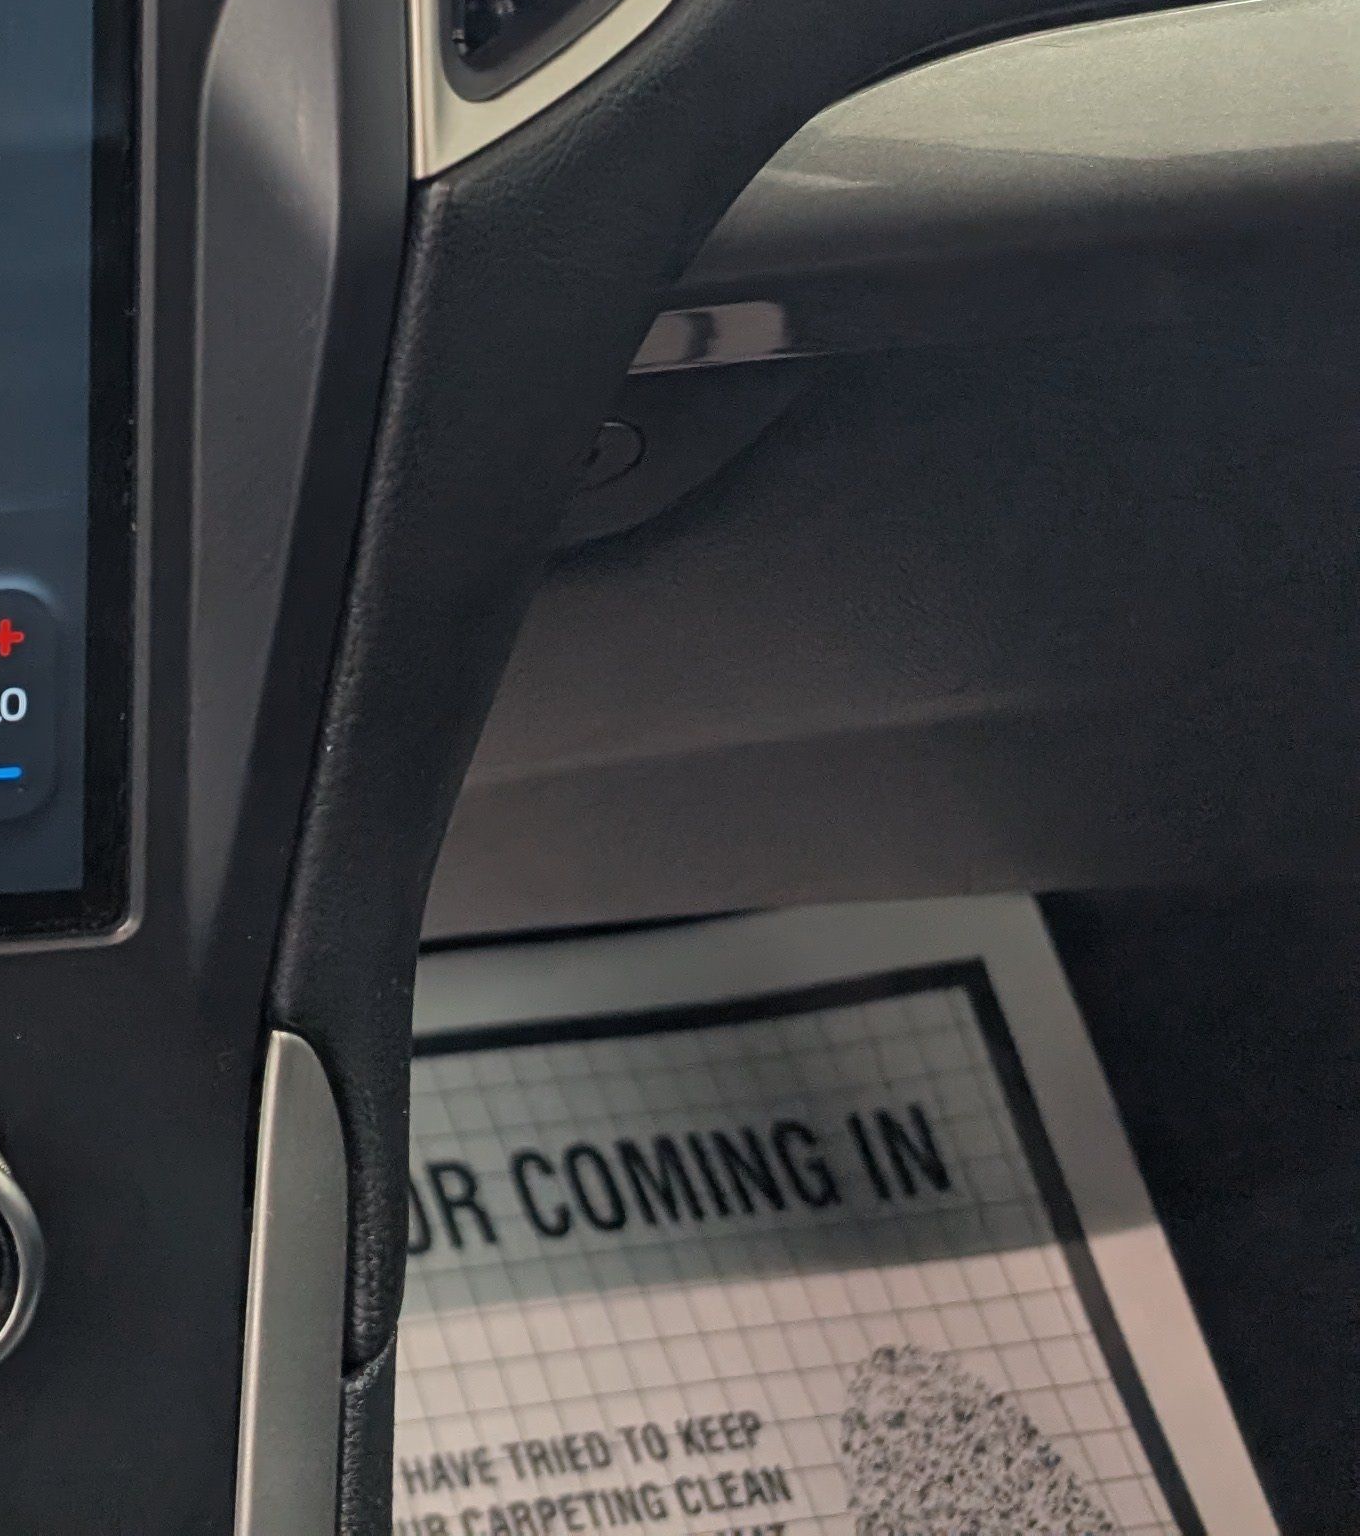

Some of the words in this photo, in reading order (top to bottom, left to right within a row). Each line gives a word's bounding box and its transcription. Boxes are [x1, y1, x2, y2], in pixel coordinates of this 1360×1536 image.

[511, 1118, 842, 1237] COMING
[846, 1101, 952, 1201] IN
[399, 1445, 500, 1495] HAVE
[502, 1430, 611, 1481] TRIED
[618, 1421, 669, 1464] TO
[676, 1410, 763, 1457] KEEP
[459, 1481, 669, 1536] CARPETING
[676, 1464, 793, 1517] CLEAN
